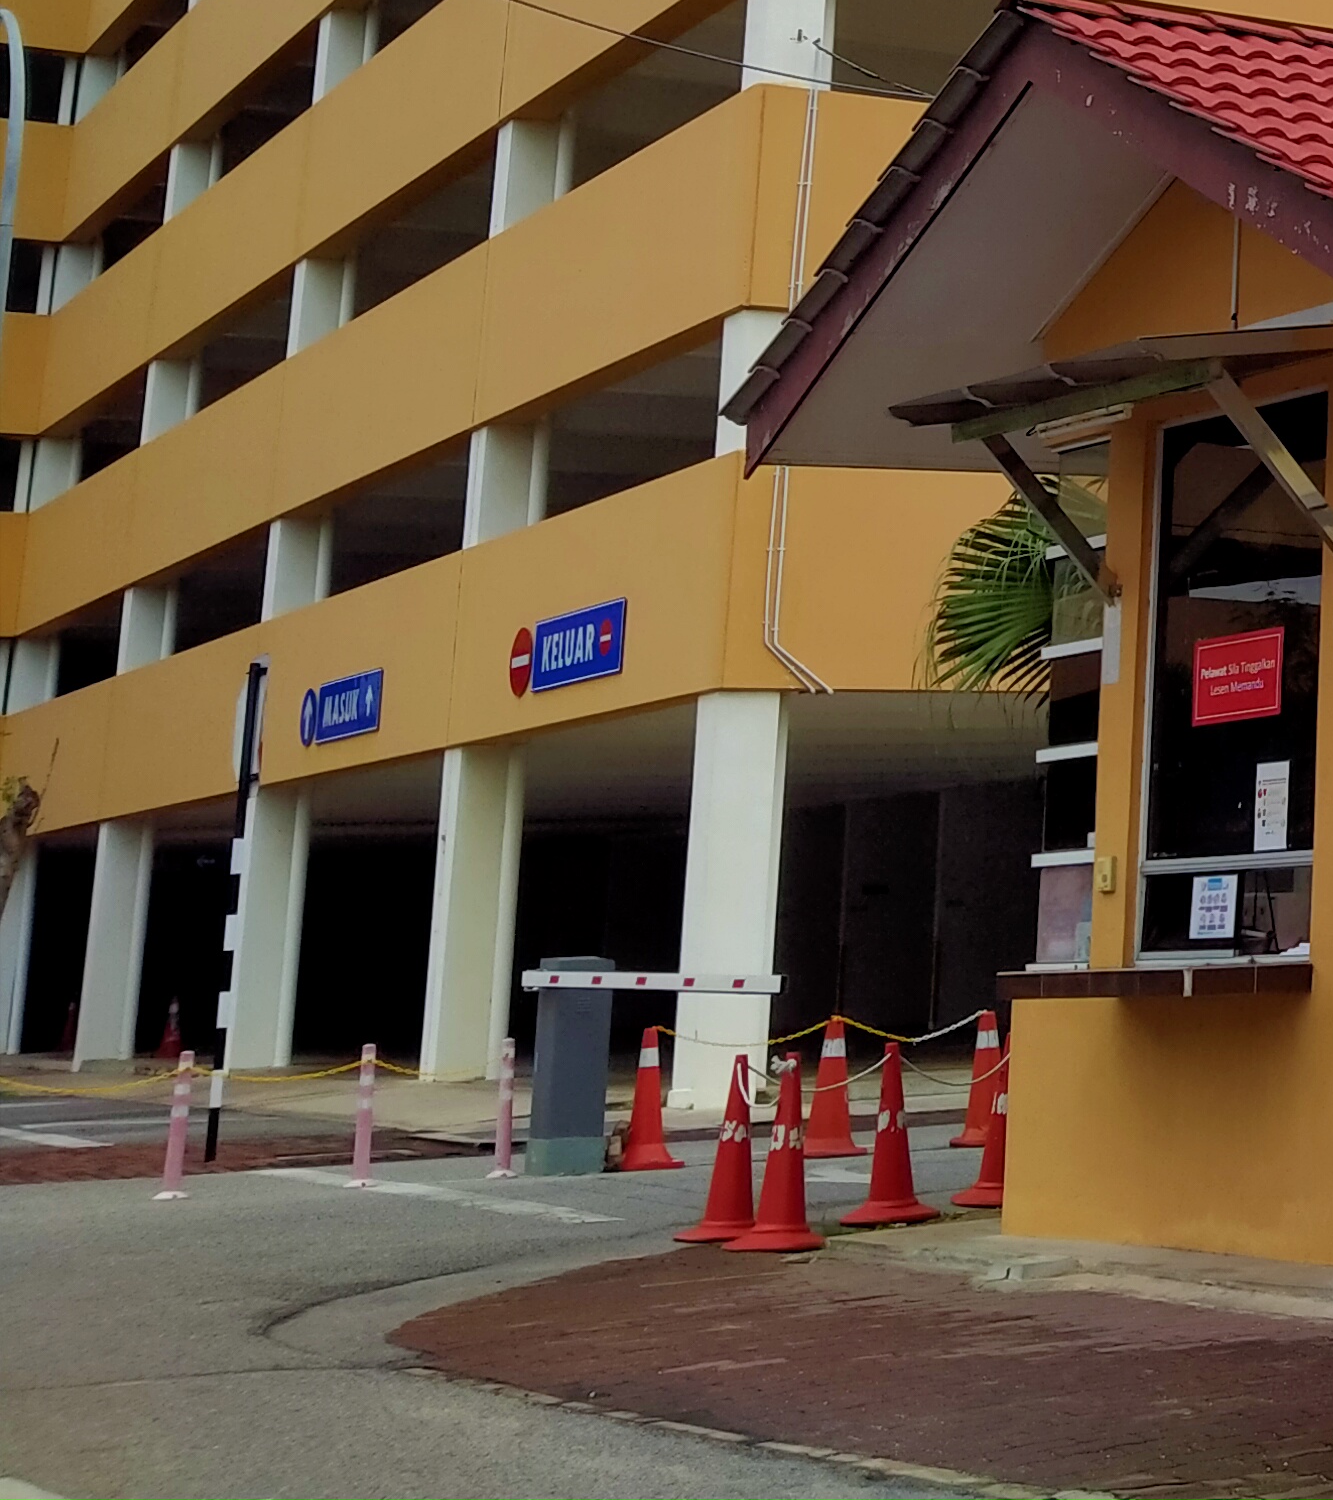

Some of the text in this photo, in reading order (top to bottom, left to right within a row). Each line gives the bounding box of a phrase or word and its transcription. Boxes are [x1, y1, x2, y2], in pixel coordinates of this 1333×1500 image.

[541, 623, 595, 672] KELUAR
[1200, 659, 1275, 680] Pelawat Sila Tinggalkan
[1210, 677, 1264, 696] Lesen Memandu
[322, 688, 359, 727] MASUK
